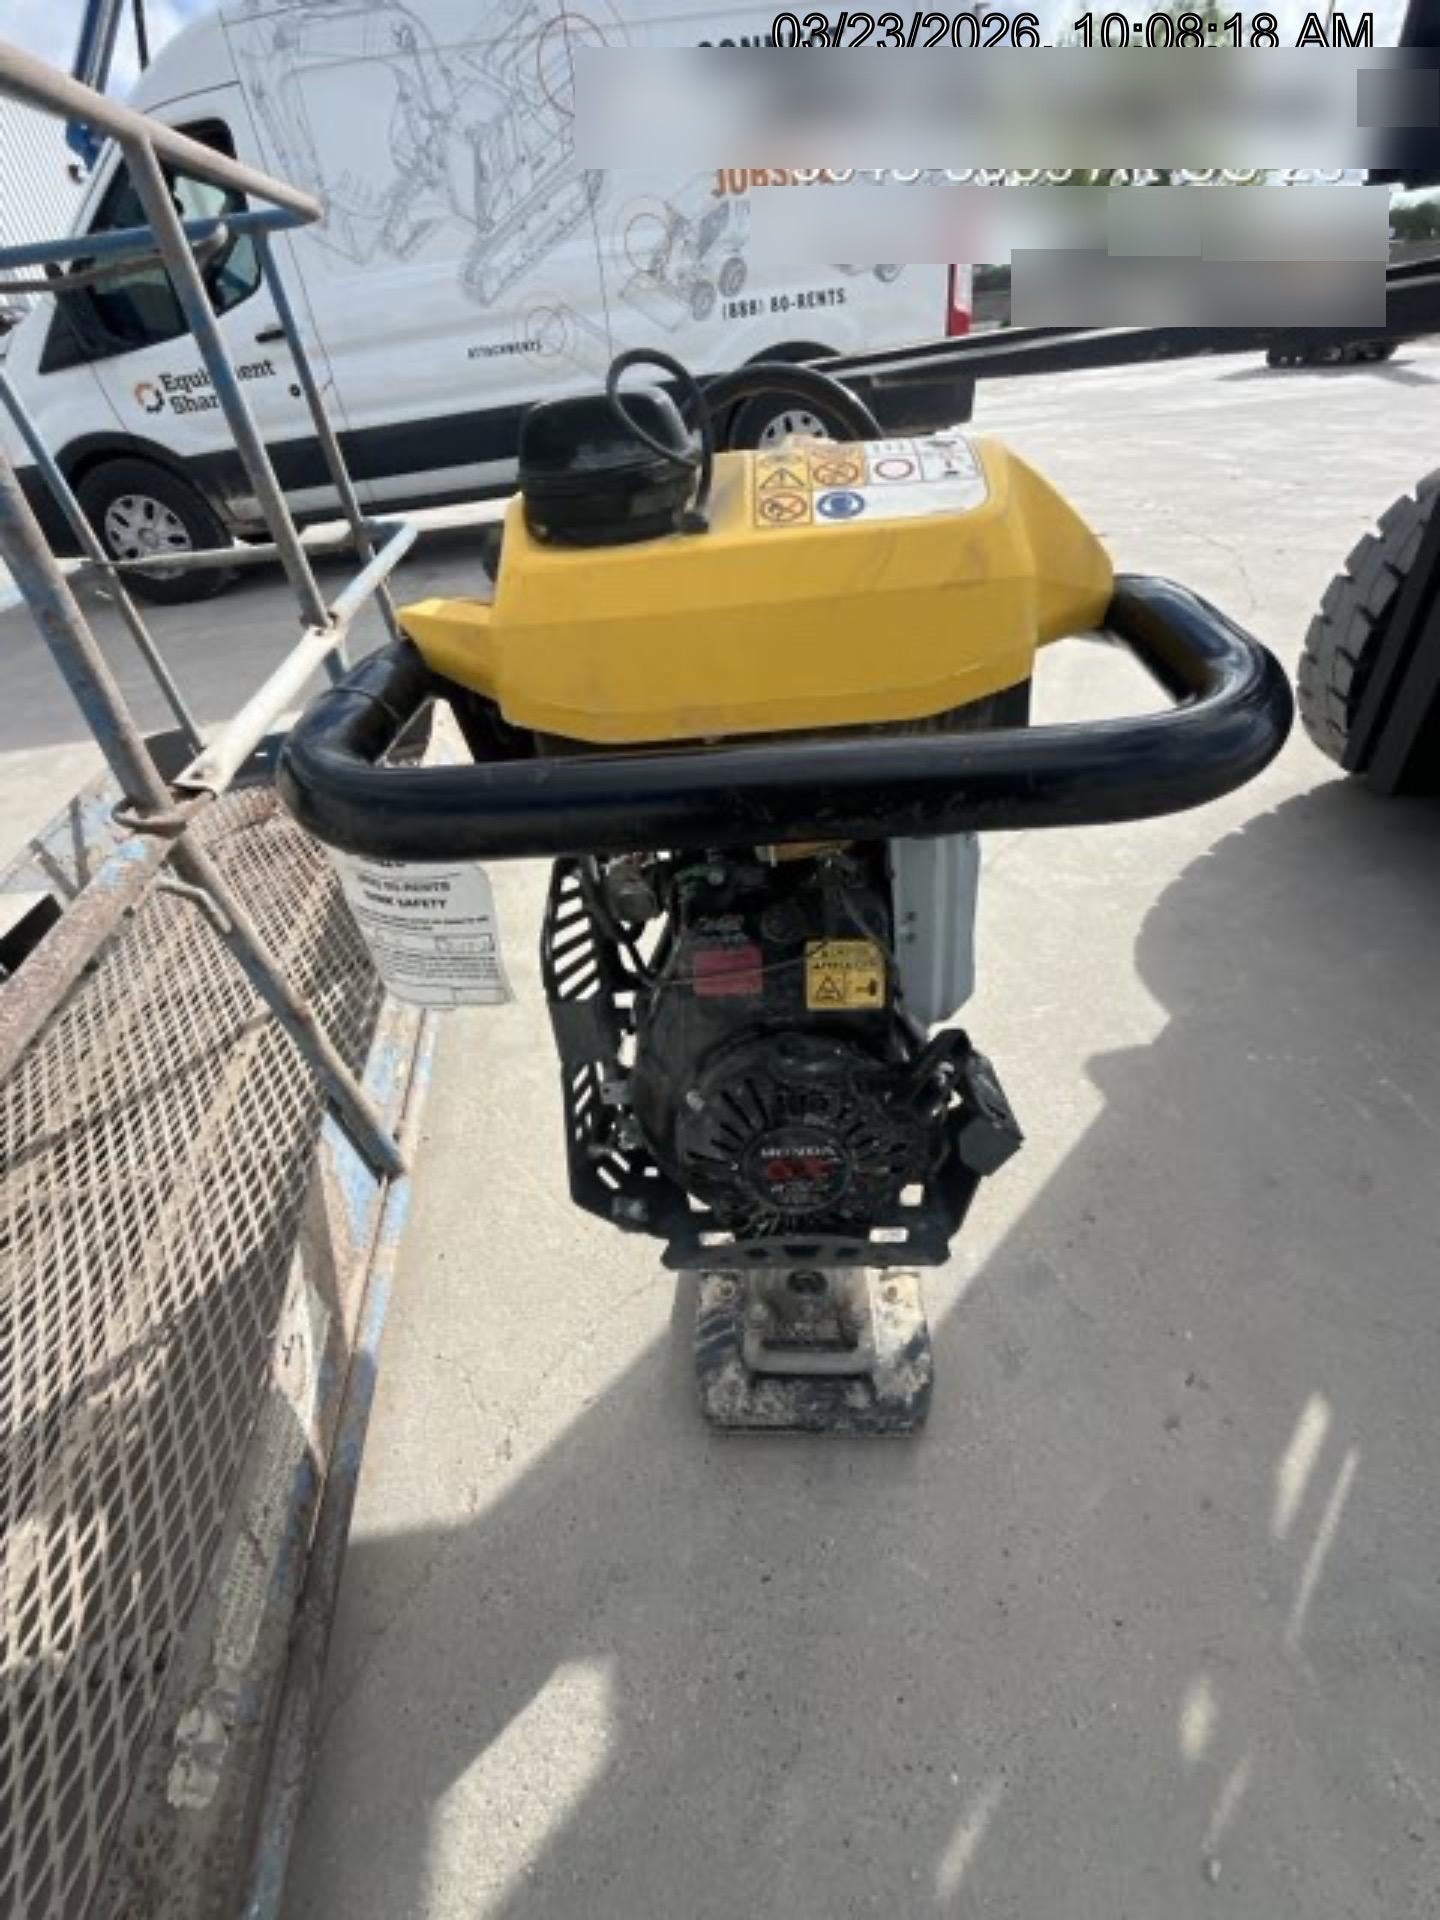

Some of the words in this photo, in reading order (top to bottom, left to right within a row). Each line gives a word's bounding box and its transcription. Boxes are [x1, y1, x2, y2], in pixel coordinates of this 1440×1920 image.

[722, 299, 764, 321] (888)
[770, 286, 847, 314] 80-RENTS
[158, 358, 277, 394] Equient
[169, 394, 221, 415] Shar
